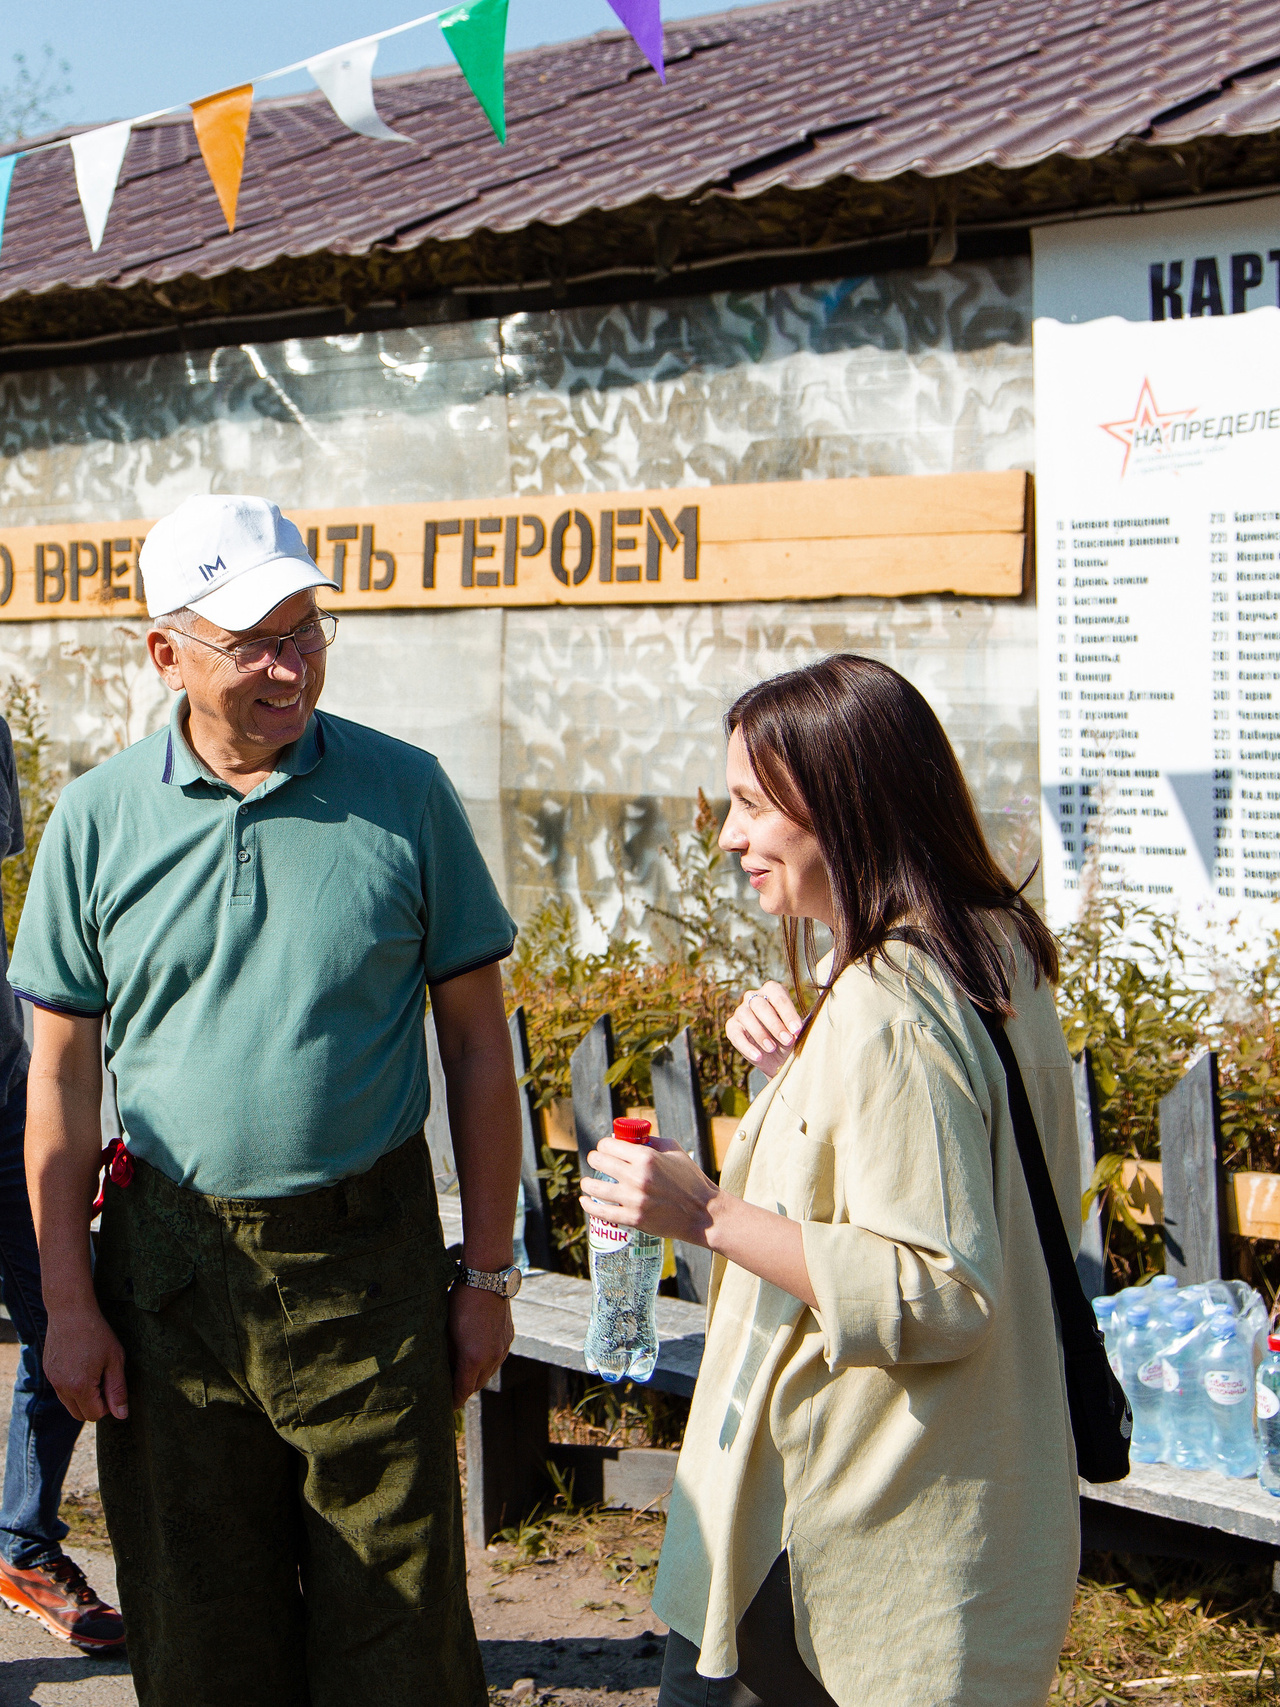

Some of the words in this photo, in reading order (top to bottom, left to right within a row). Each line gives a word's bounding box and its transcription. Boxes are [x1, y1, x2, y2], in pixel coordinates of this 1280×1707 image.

[1134, 427, 1163, 449] НА
[423, 505, 700, 590] ГЕРОЕМ
[198, 554, 227, 582] IM
